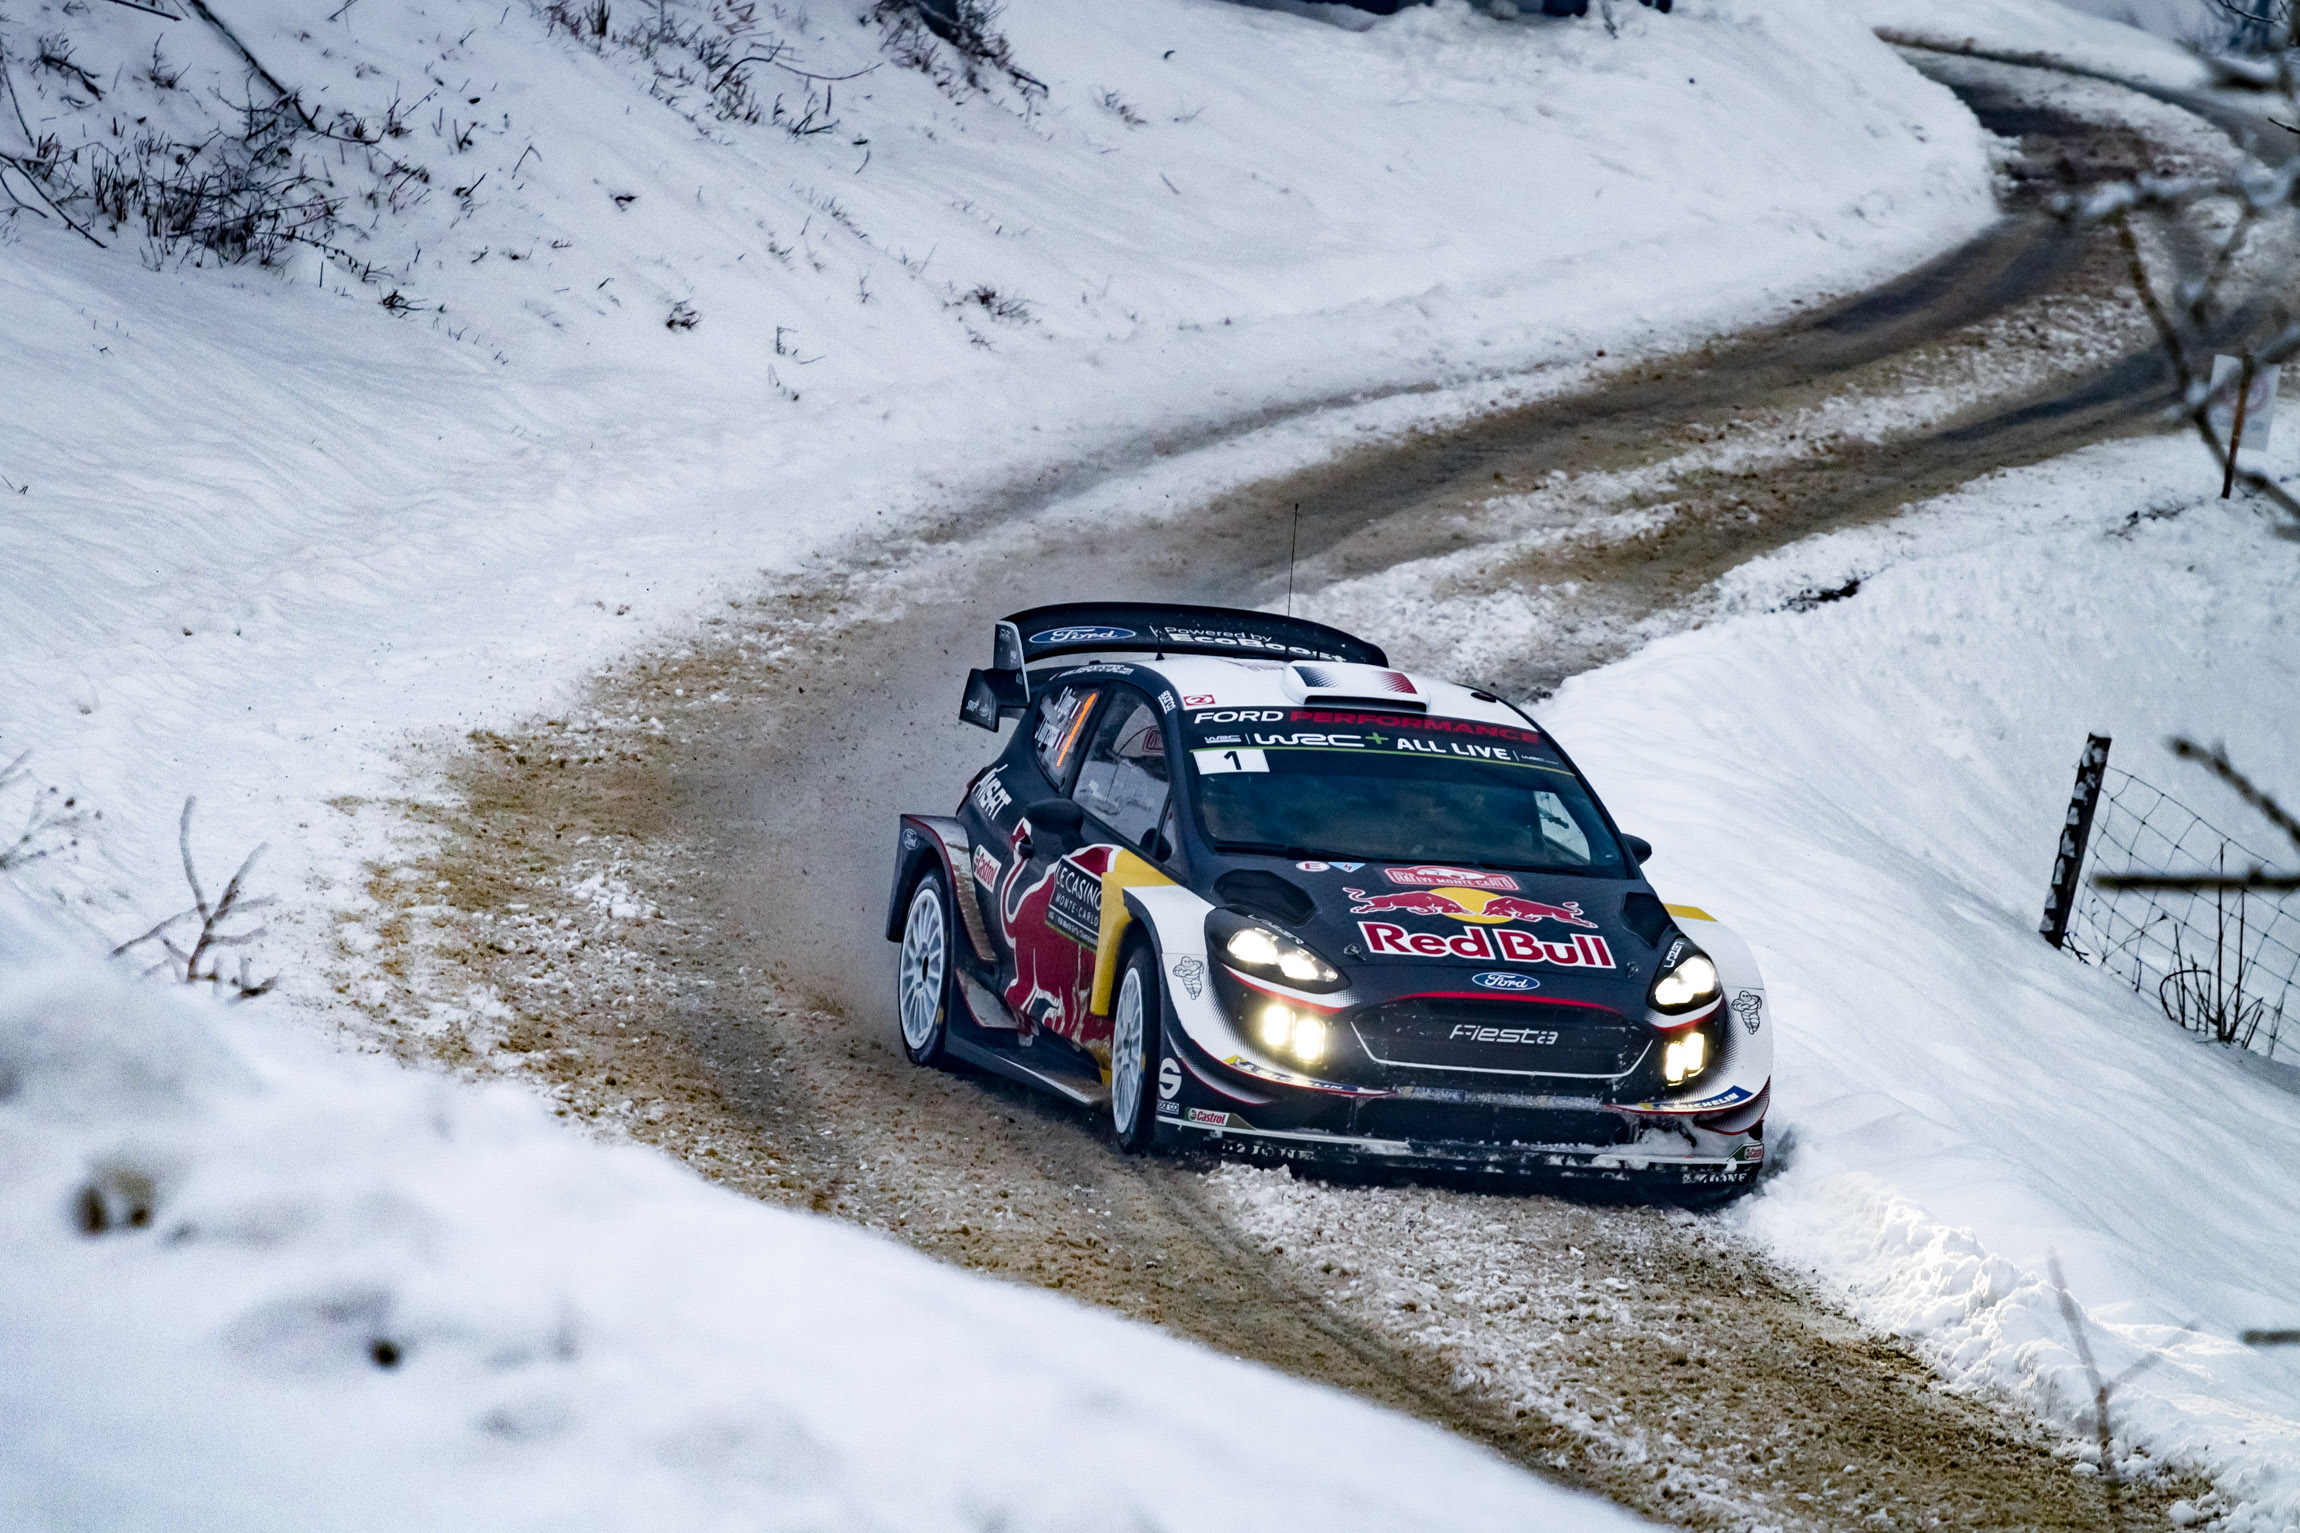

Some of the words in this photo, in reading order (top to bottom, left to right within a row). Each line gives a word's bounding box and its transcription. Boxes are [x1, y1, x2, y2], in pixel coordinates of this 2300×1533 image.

[1050, 628, 1118, 642] Ford
[1165, 626, 1247, 639] Powered
[1251, 631, 1272, 643] by
[1169, 633, 1347, 663] EcoBoost
[1194, 710, 1284, 724] FORD
[1290, 711, 1539, 744] PERFORMANCE
[1397, 738, 1446, 753] ALL
[1450, 742, 1511, 760] LIVE
[1223, 750, 1242, 771] 1
[976, 852, 999, 888] Castrol
[1305, 862, 1323, 871] E
[1436, 878, 1473, 886] MONTE
[1475, 878, 1513, 889] CARLO
[1358, 922, 1495, 960] Red
[1493, 929, 1616, 969] Bull
[1486, 974, 1528, 989] Ford
[1450, 1024, 1559, 1045] Fiesta
[1197, 1110, 1226, 1124] Castrol
